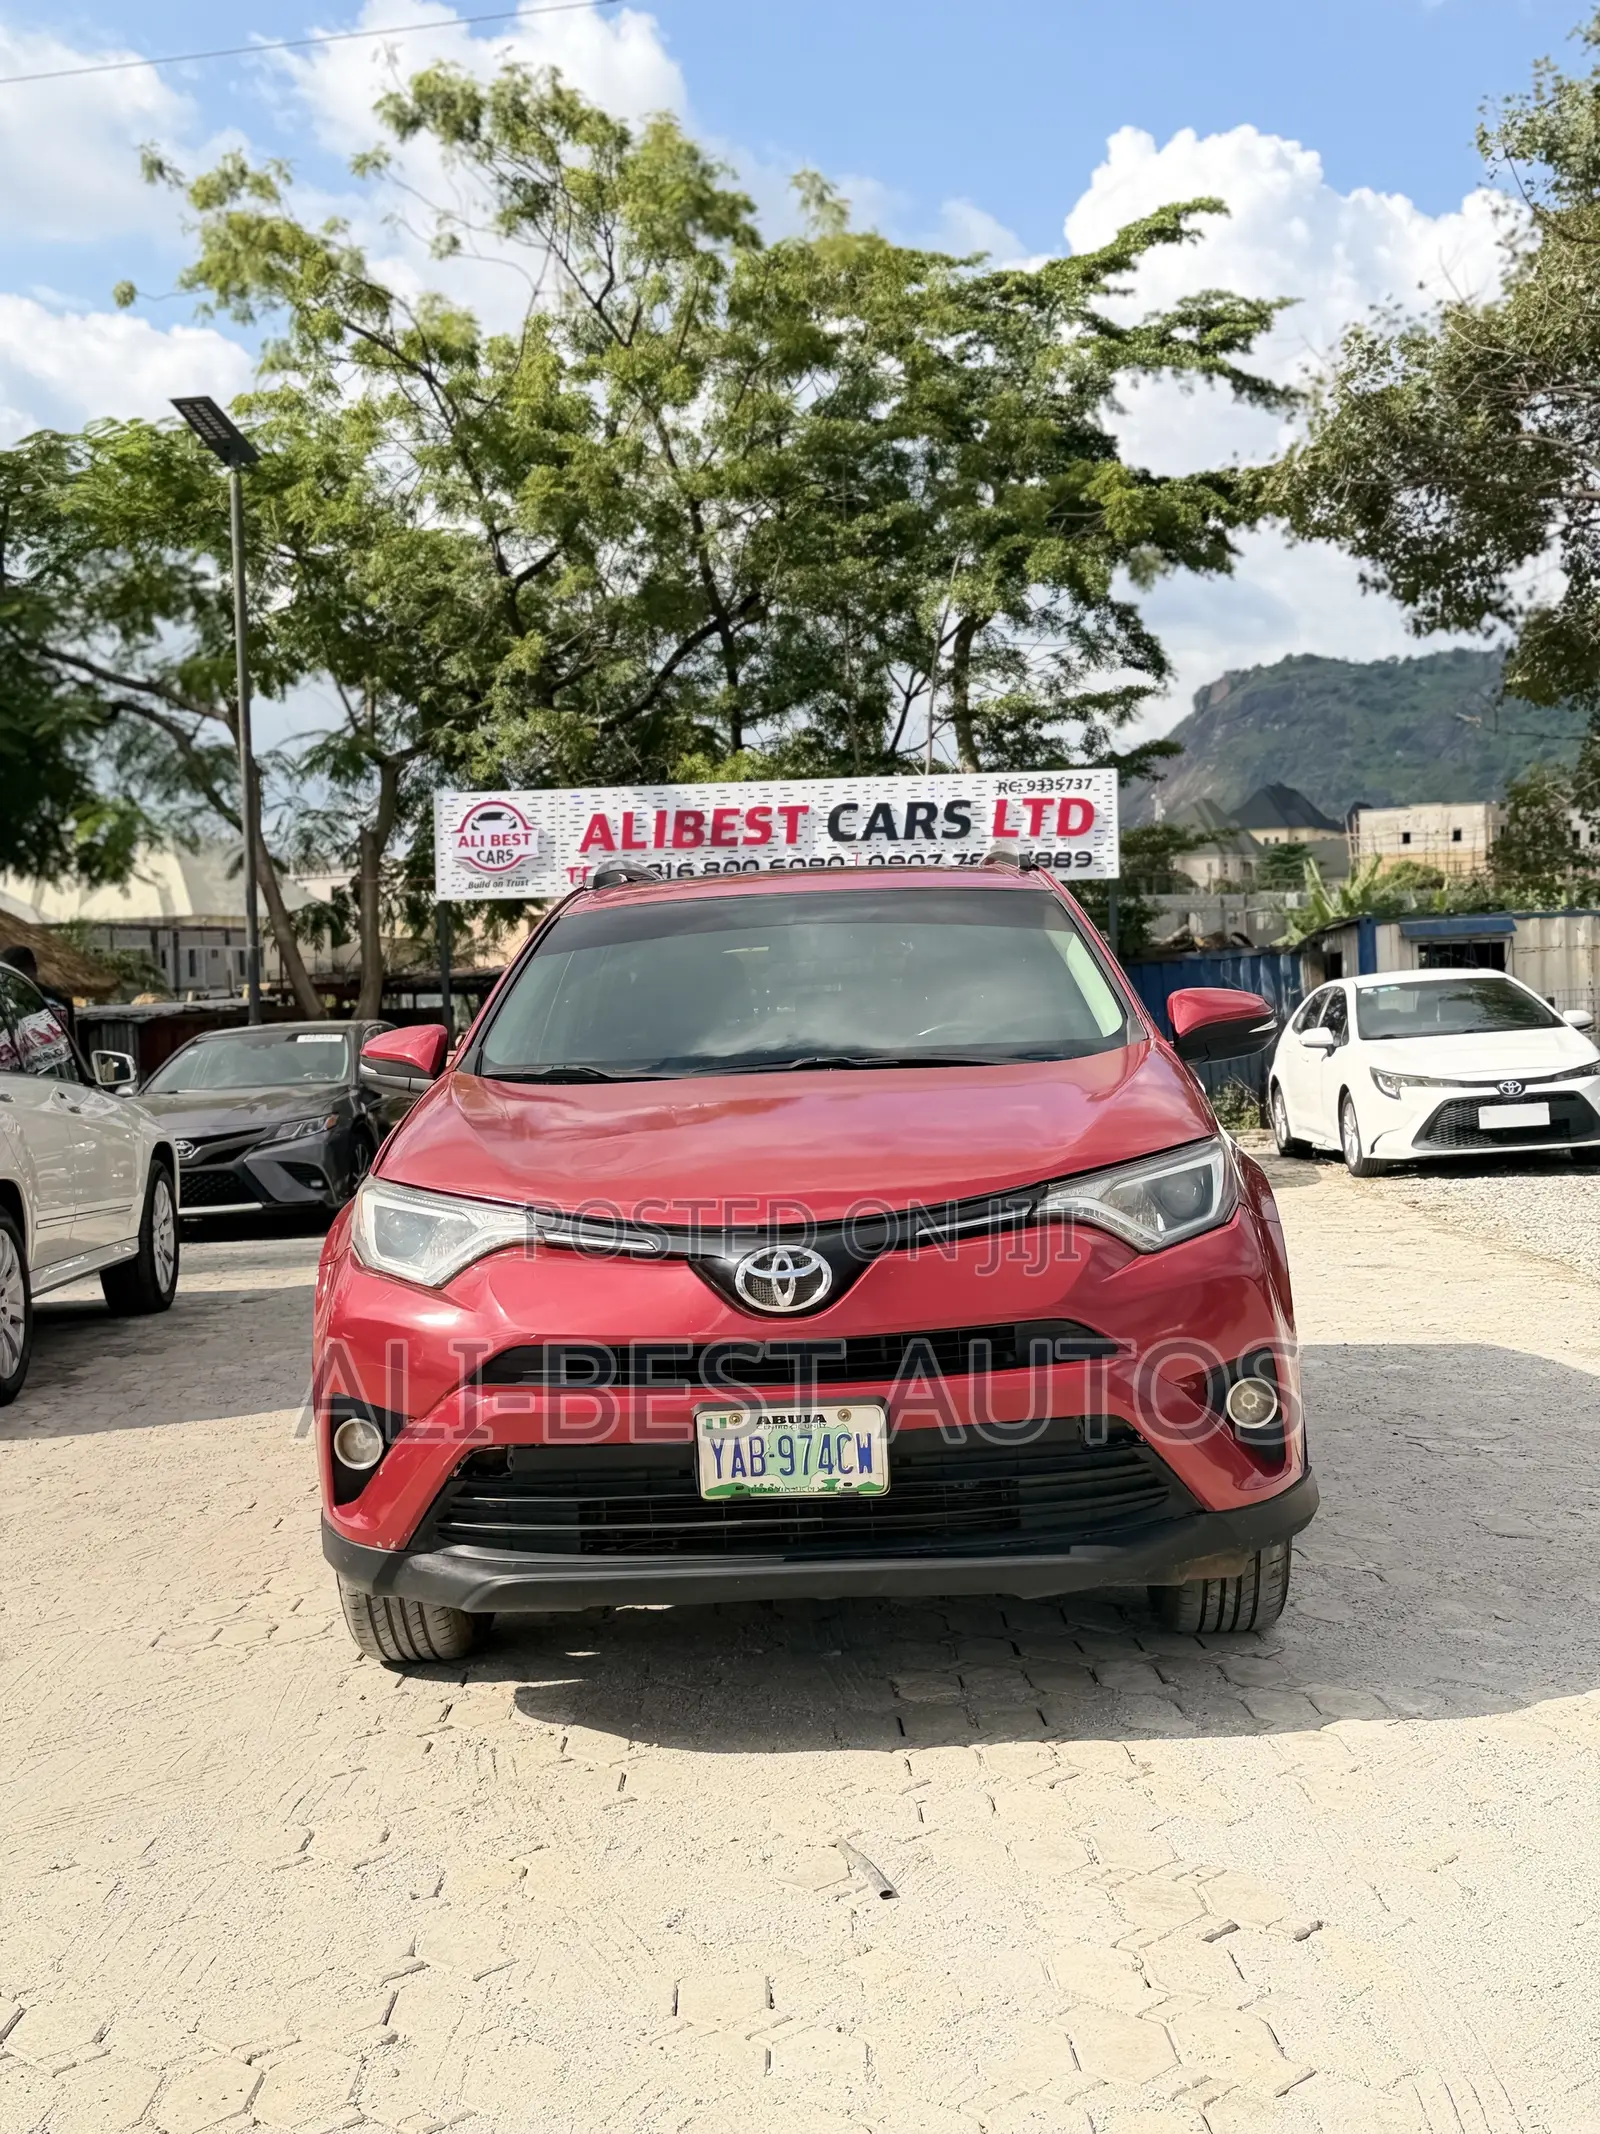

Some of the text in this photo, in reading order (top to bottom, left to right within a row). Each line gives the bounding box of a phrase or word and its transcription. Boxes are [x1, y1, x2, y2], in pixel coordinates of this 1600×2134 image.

[1027, 778, 1093, 792] 9335737
[579, 797, 1095, 854] ALIBEST CARS LTD
[457, 832, 533, 848] ALI BEST
[476, 849, 514, 865] CARS
[467, 879, 530, 889] Build on Trust
[756, 1414, 827, 1425] ABUJA
[709, 1432, 873, 1479] YAB-974CW
